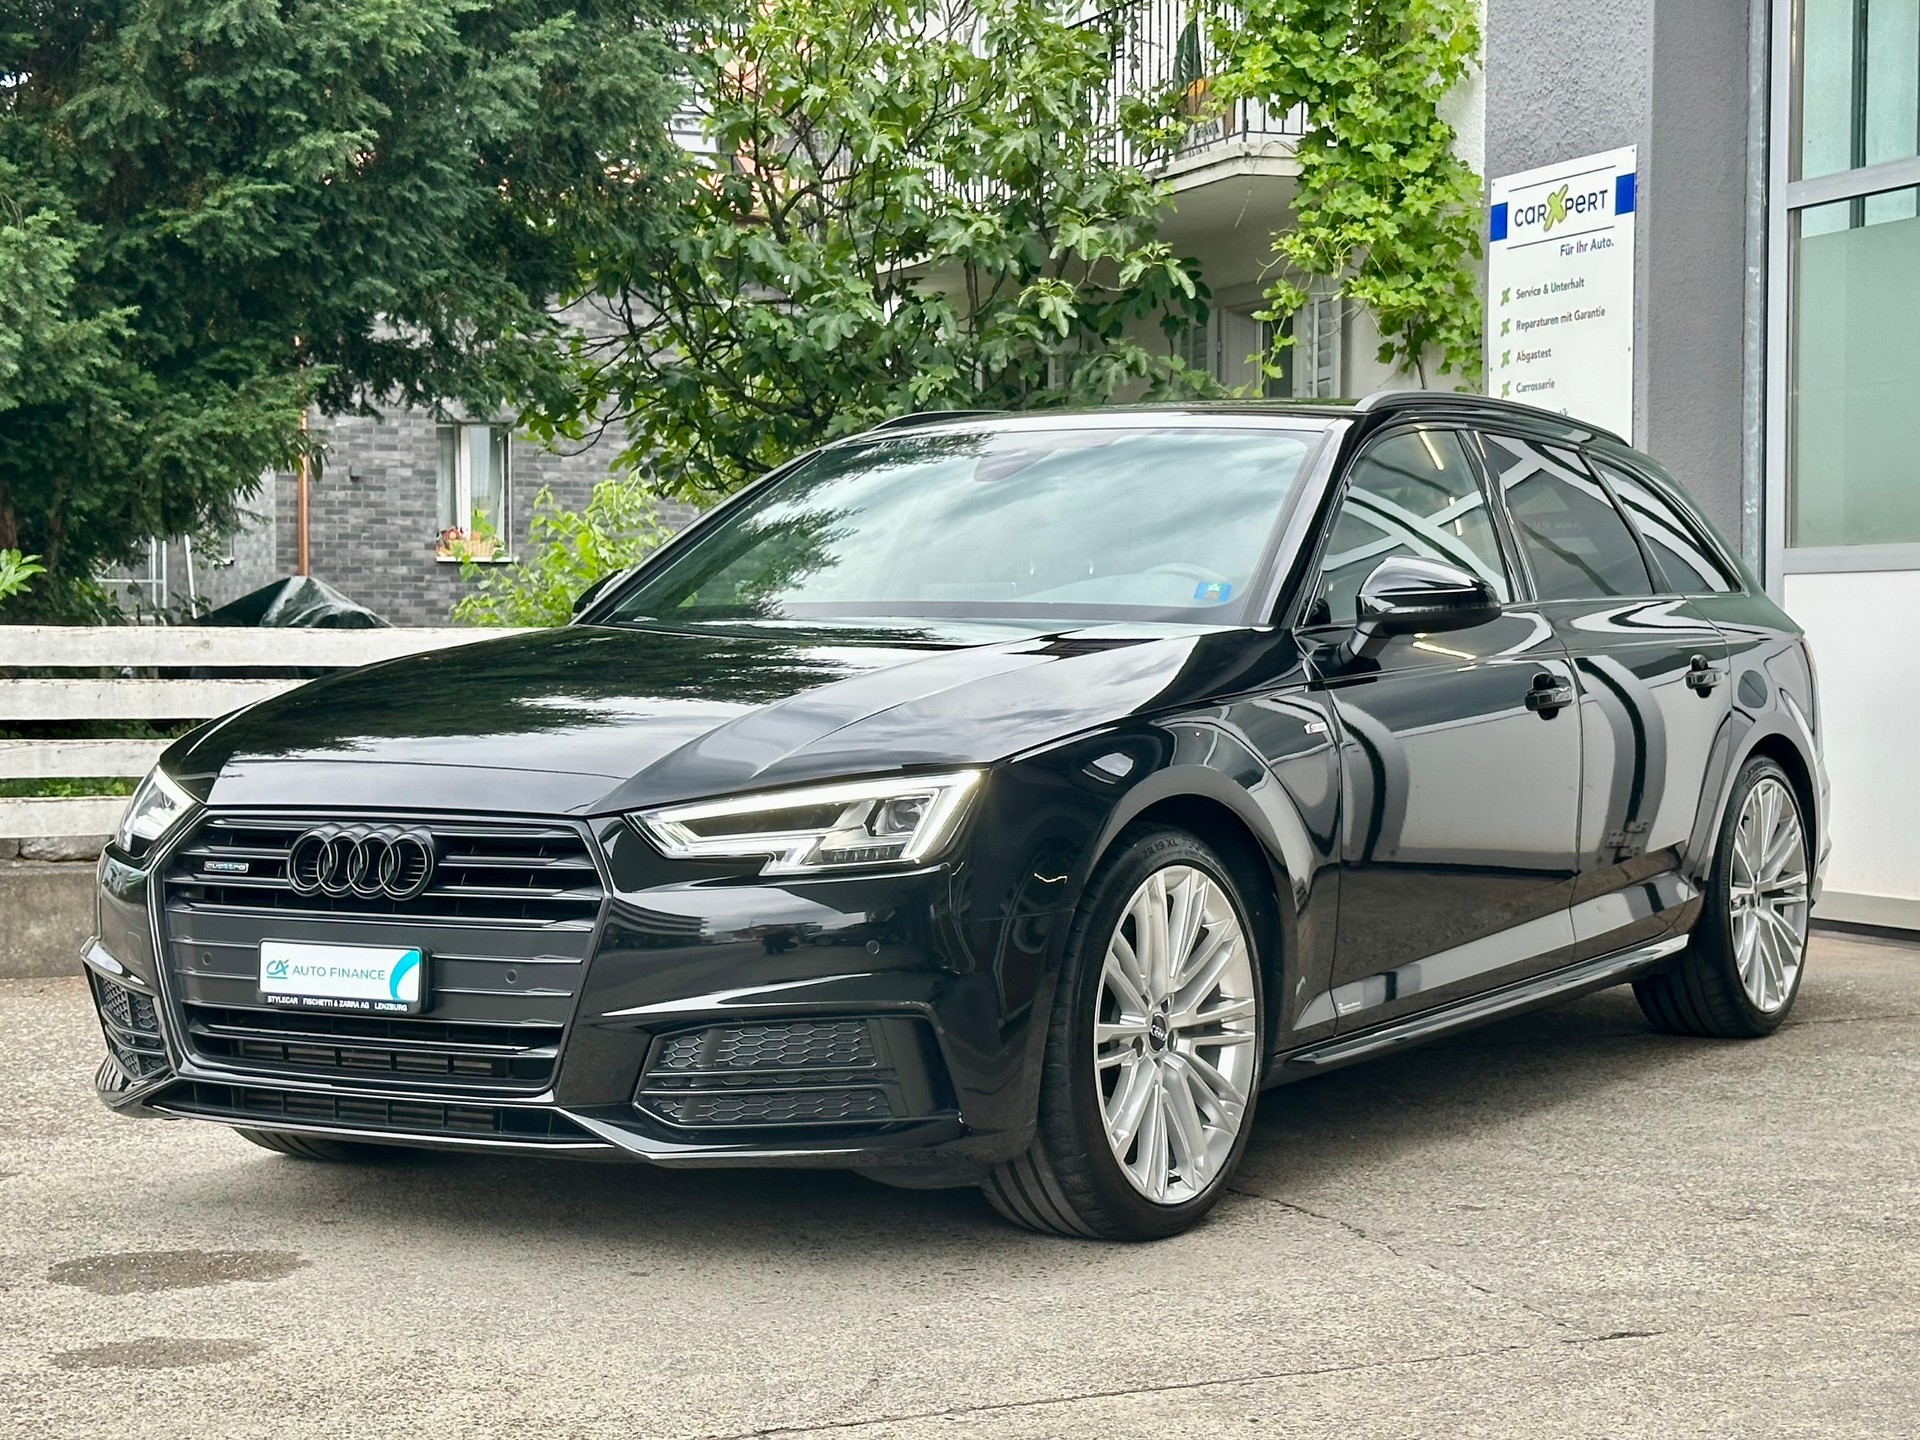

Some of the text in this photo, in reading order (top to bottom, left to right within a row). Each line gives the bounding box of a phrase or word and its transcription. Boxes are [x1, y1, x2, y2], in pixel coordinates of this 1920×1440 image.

[1560, 238, 1614, 256] Für Ihr Auto.
[1516, 277, 1585, 300] Service & Unterhalt
[1516, 306, 1605, 332] Reparaturen mit Garantie
[1516, 348, 1552, 363] Abgastest
[1516, 378, 1555, 393] Carrosserie
[1166, 838, 1178, 847] XL
[292, 965, 326, 977] AUTO
[330, 967, 385, 980] FINANCE
[267, 995, 299, 1005] STYLECAR
[360, 1001, 370, 1009] AG
